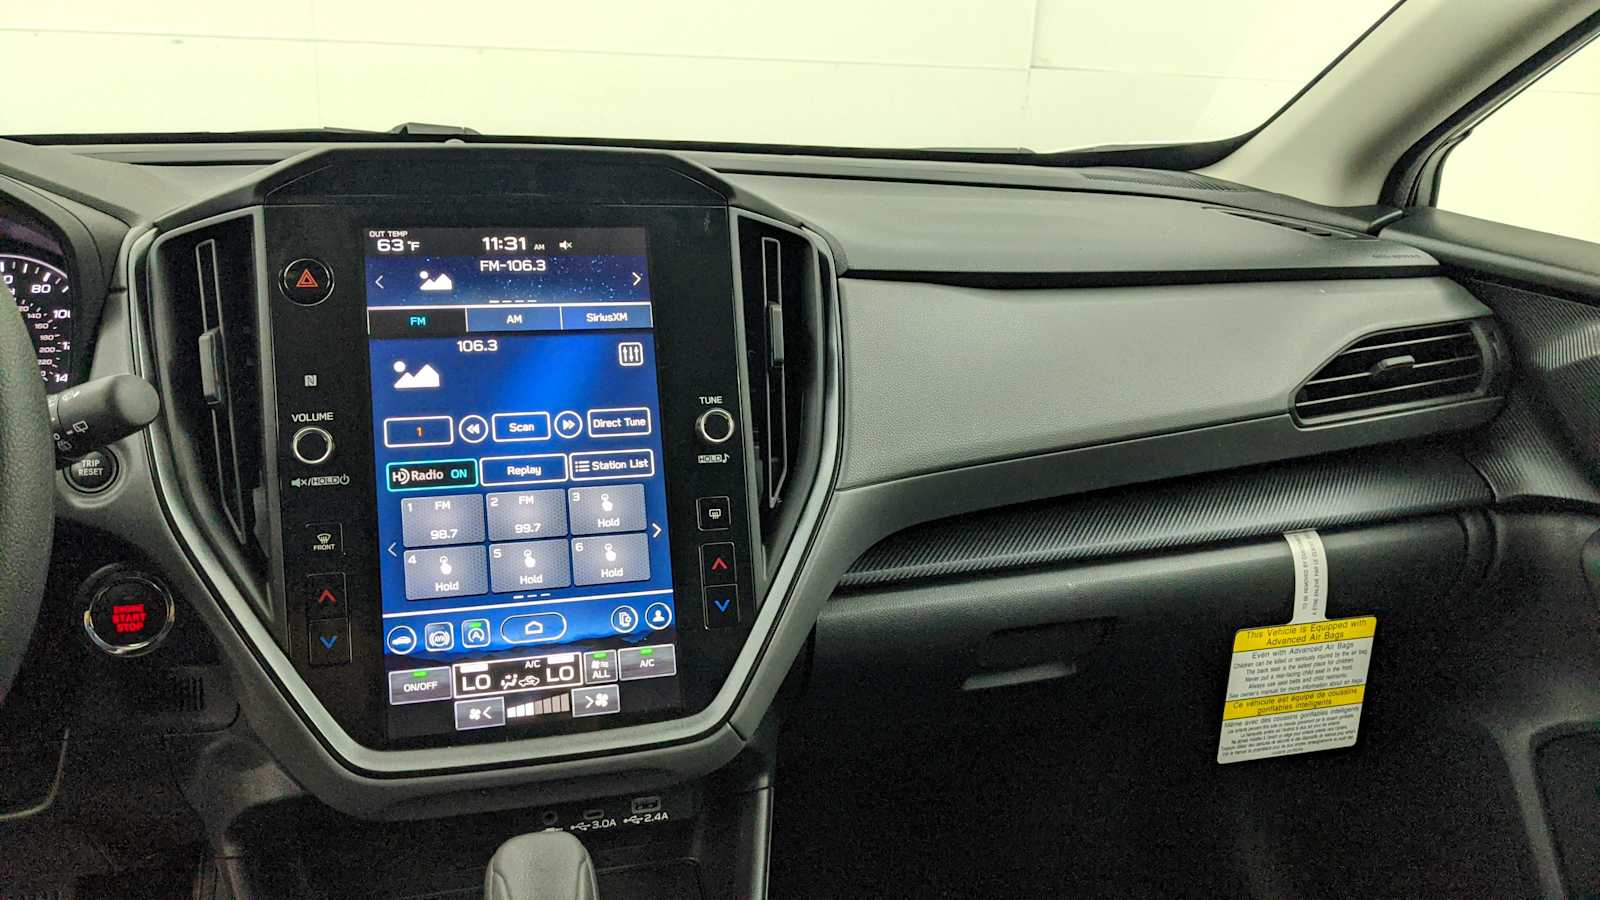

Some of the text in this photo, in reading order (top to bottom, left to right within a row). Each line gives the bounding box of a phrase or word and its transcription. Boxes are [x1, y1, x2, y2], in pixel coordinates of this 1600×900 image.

[376, 239, 404, 252] 63
[482, 236, 526, 250] 11:31
[480, 260, 546, 272] FM-106.3
[31, 284, 52, 294] 80
[410, 316, 426, 326] FM
[506, 314, 522, 324] AM
[586, 312, 628, 322] SiriusXM
[457, 340, 498, 352] 106.3
[699, 396, 722, 404] TUNE
[292, 412, 334, 422] VOLUME
[593, 416, 646, 429] Direct Tune
[416, 426, 422, 437] 1
[509, 422, 534, 433] Scan
[82, 459, 100, 468] TRIP
[698, 454, 722, 463] HOLD
[592, 458, 649, 471] Station List
[79, 468, 103, 476] RESET
[411, 469, 444, 482] Radio
[450, 468, 467, 479] ON
[507, 466, 542, 478] Replay
[490, 496, 534, 507] 2 FM
[572, 492, 580, 502] 3
[407, 501, 450, 512] 1 FM
[598, 517, 620, 528] Hold
[430, 529, 458, 540] 98.7
[514, 524, 541, 534] 99.7
[575, 542, 583, 552] 6
[493, 549, 501, 558] 5
[408, 556, 417, 565] 4
[601, 567, 624, 578] Hold
[520, 574, 542, 585] Hold
[435, 581, 459, 592] Hold
[112, 612, 147, 624] START
[116, 622, 144, 632] STOP
[1268, 628, 1296, 636] Vehicle
[1310, 623, 1348, 632] Equipped
[1266, 636, 1307, 646] Advanced
[1324, 631, 1344, 640] Bags
[1290, 646, 1324, 655] Advanced
[1337, 642, 1354, 650] Bags
[525, 660, 541, 668] A/C
[640, 659, 654, 668] A/C
[546, 666, 574, 681] LO
[592, 670, 610, 680] ALL
[403, 680, 438, 692] ON/OFF
[462, 674, 491, 692] LO
[1328, 688, 1357, 697] coussins
[1257, 699, 1332, 715] gonflables intelligents
[644, 812, 669, 823] 2.4A
[592, 819, 617, 830] 3.0A
